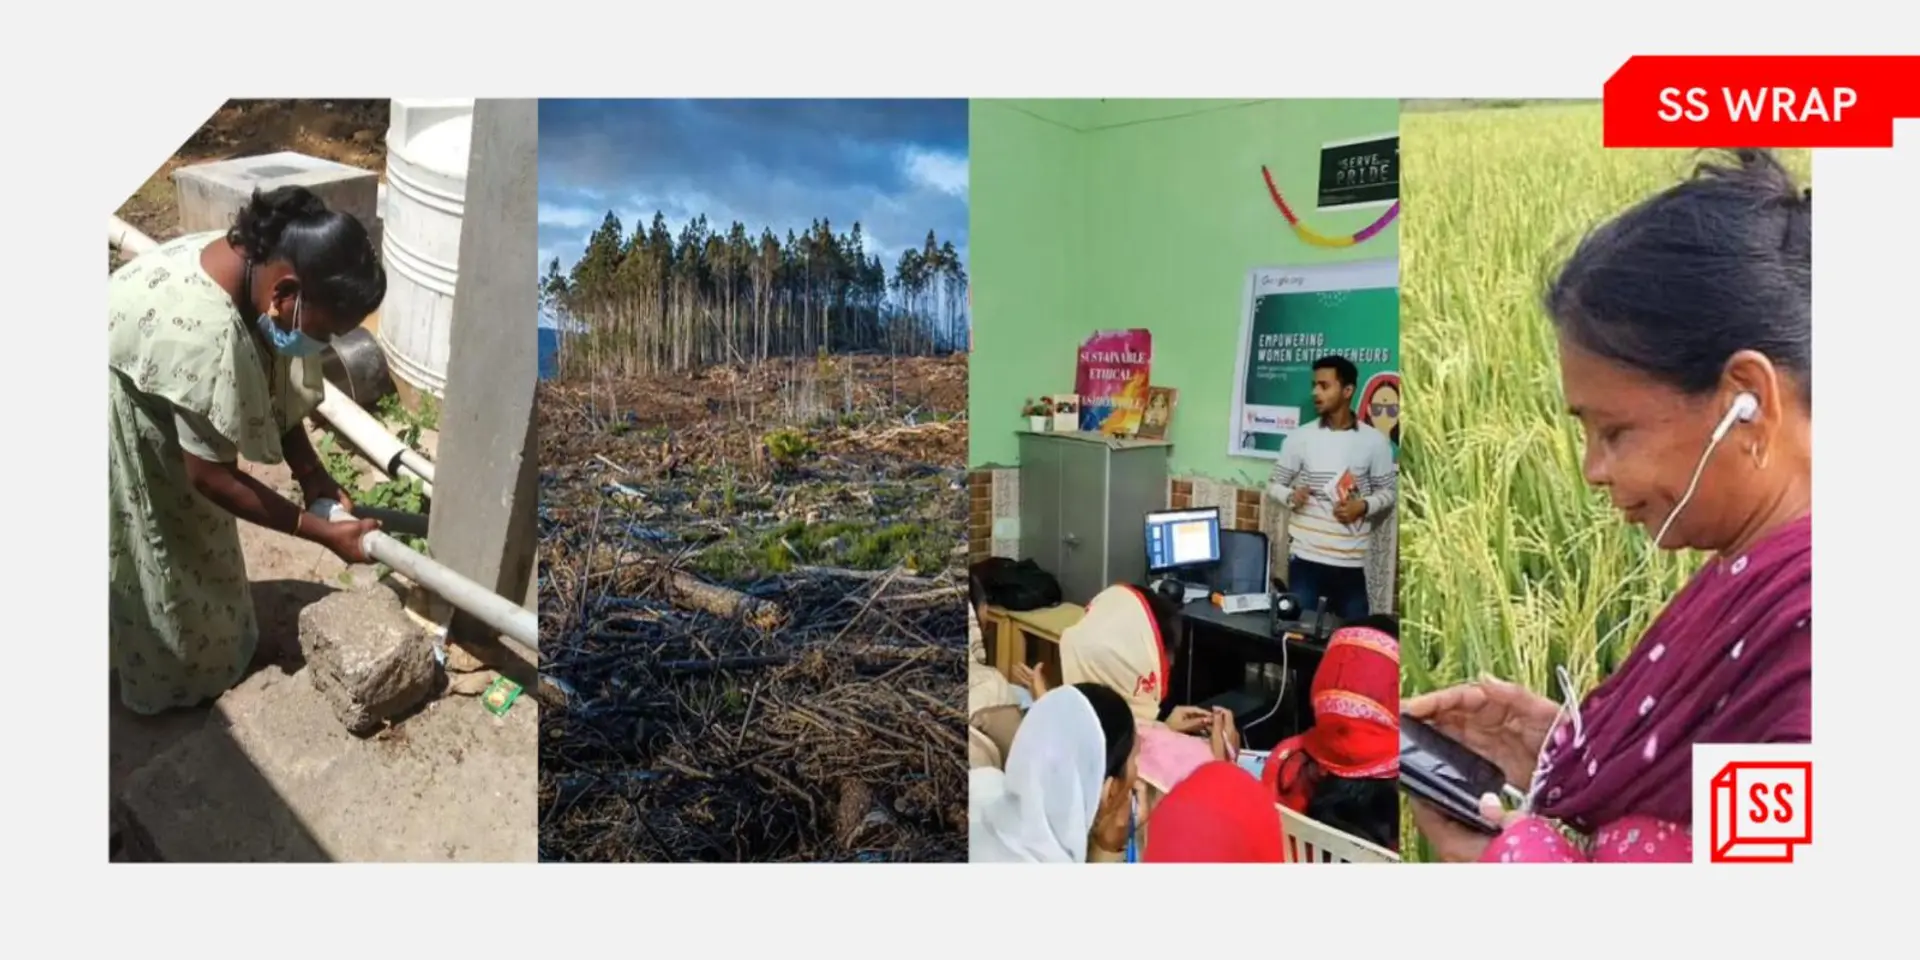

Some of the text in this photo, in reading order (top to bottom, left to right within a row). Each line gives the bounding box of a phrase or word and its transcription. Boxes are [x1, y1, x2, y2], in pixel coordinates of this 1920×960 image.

[1341, 153, 1380, 169] SERVE
[1336, 164, 1389, 185] PRIDE
[1259, 333, 1324, 347] EMPOWERING
[1080, 351, 1146, 364] SUSTAINABLE
[1258, 348, 1292, 362] WOMEN
[1089, 368, 1131, 380] ETHICAL
